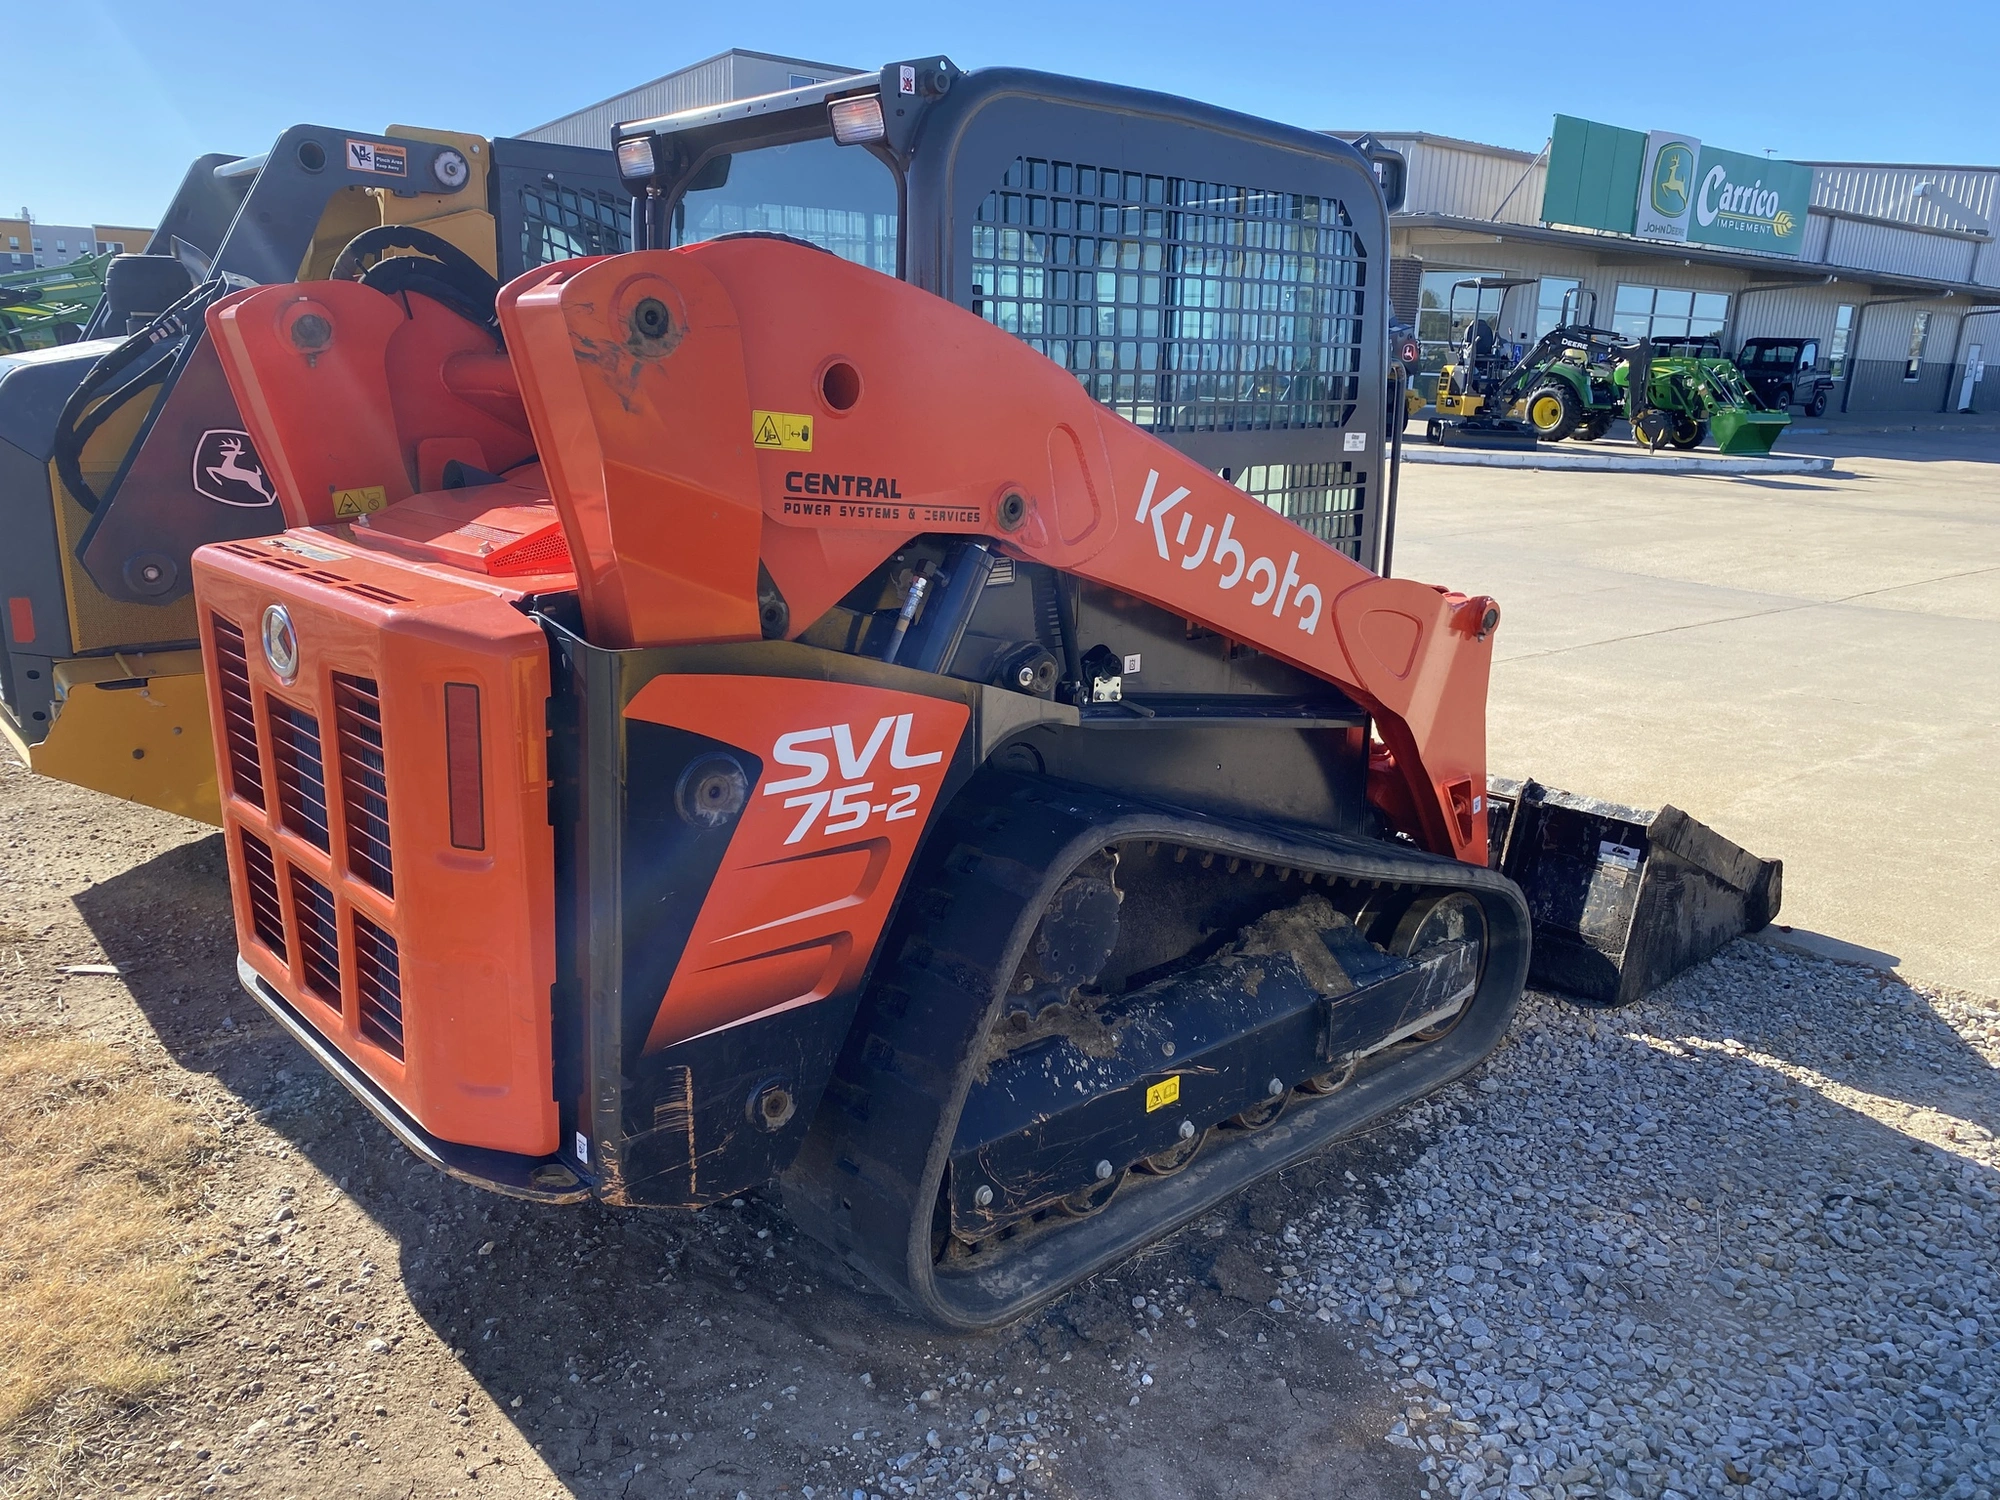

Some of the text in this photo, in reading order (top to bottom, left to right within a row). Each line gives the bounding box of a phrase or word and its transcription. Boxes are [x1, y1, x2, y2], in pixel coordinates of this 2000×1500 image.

[1696, 164, 1779, 227] Carrico
[1716, 218, 1771, 234] IMPLEMENT
[1561, 337, 1589, 350] DEERE
[785, 471, 902, 499] CENTRAL
[783, 502, 831, 516] POWER
[839, 505, 900, 520] SYSTEMS
[908, 508, 916, 520] &
[1135, 468, 1322, 636] Kubota
[763, 712, 943, 796] SVL
[783, 782, 921, 846] 75-2
